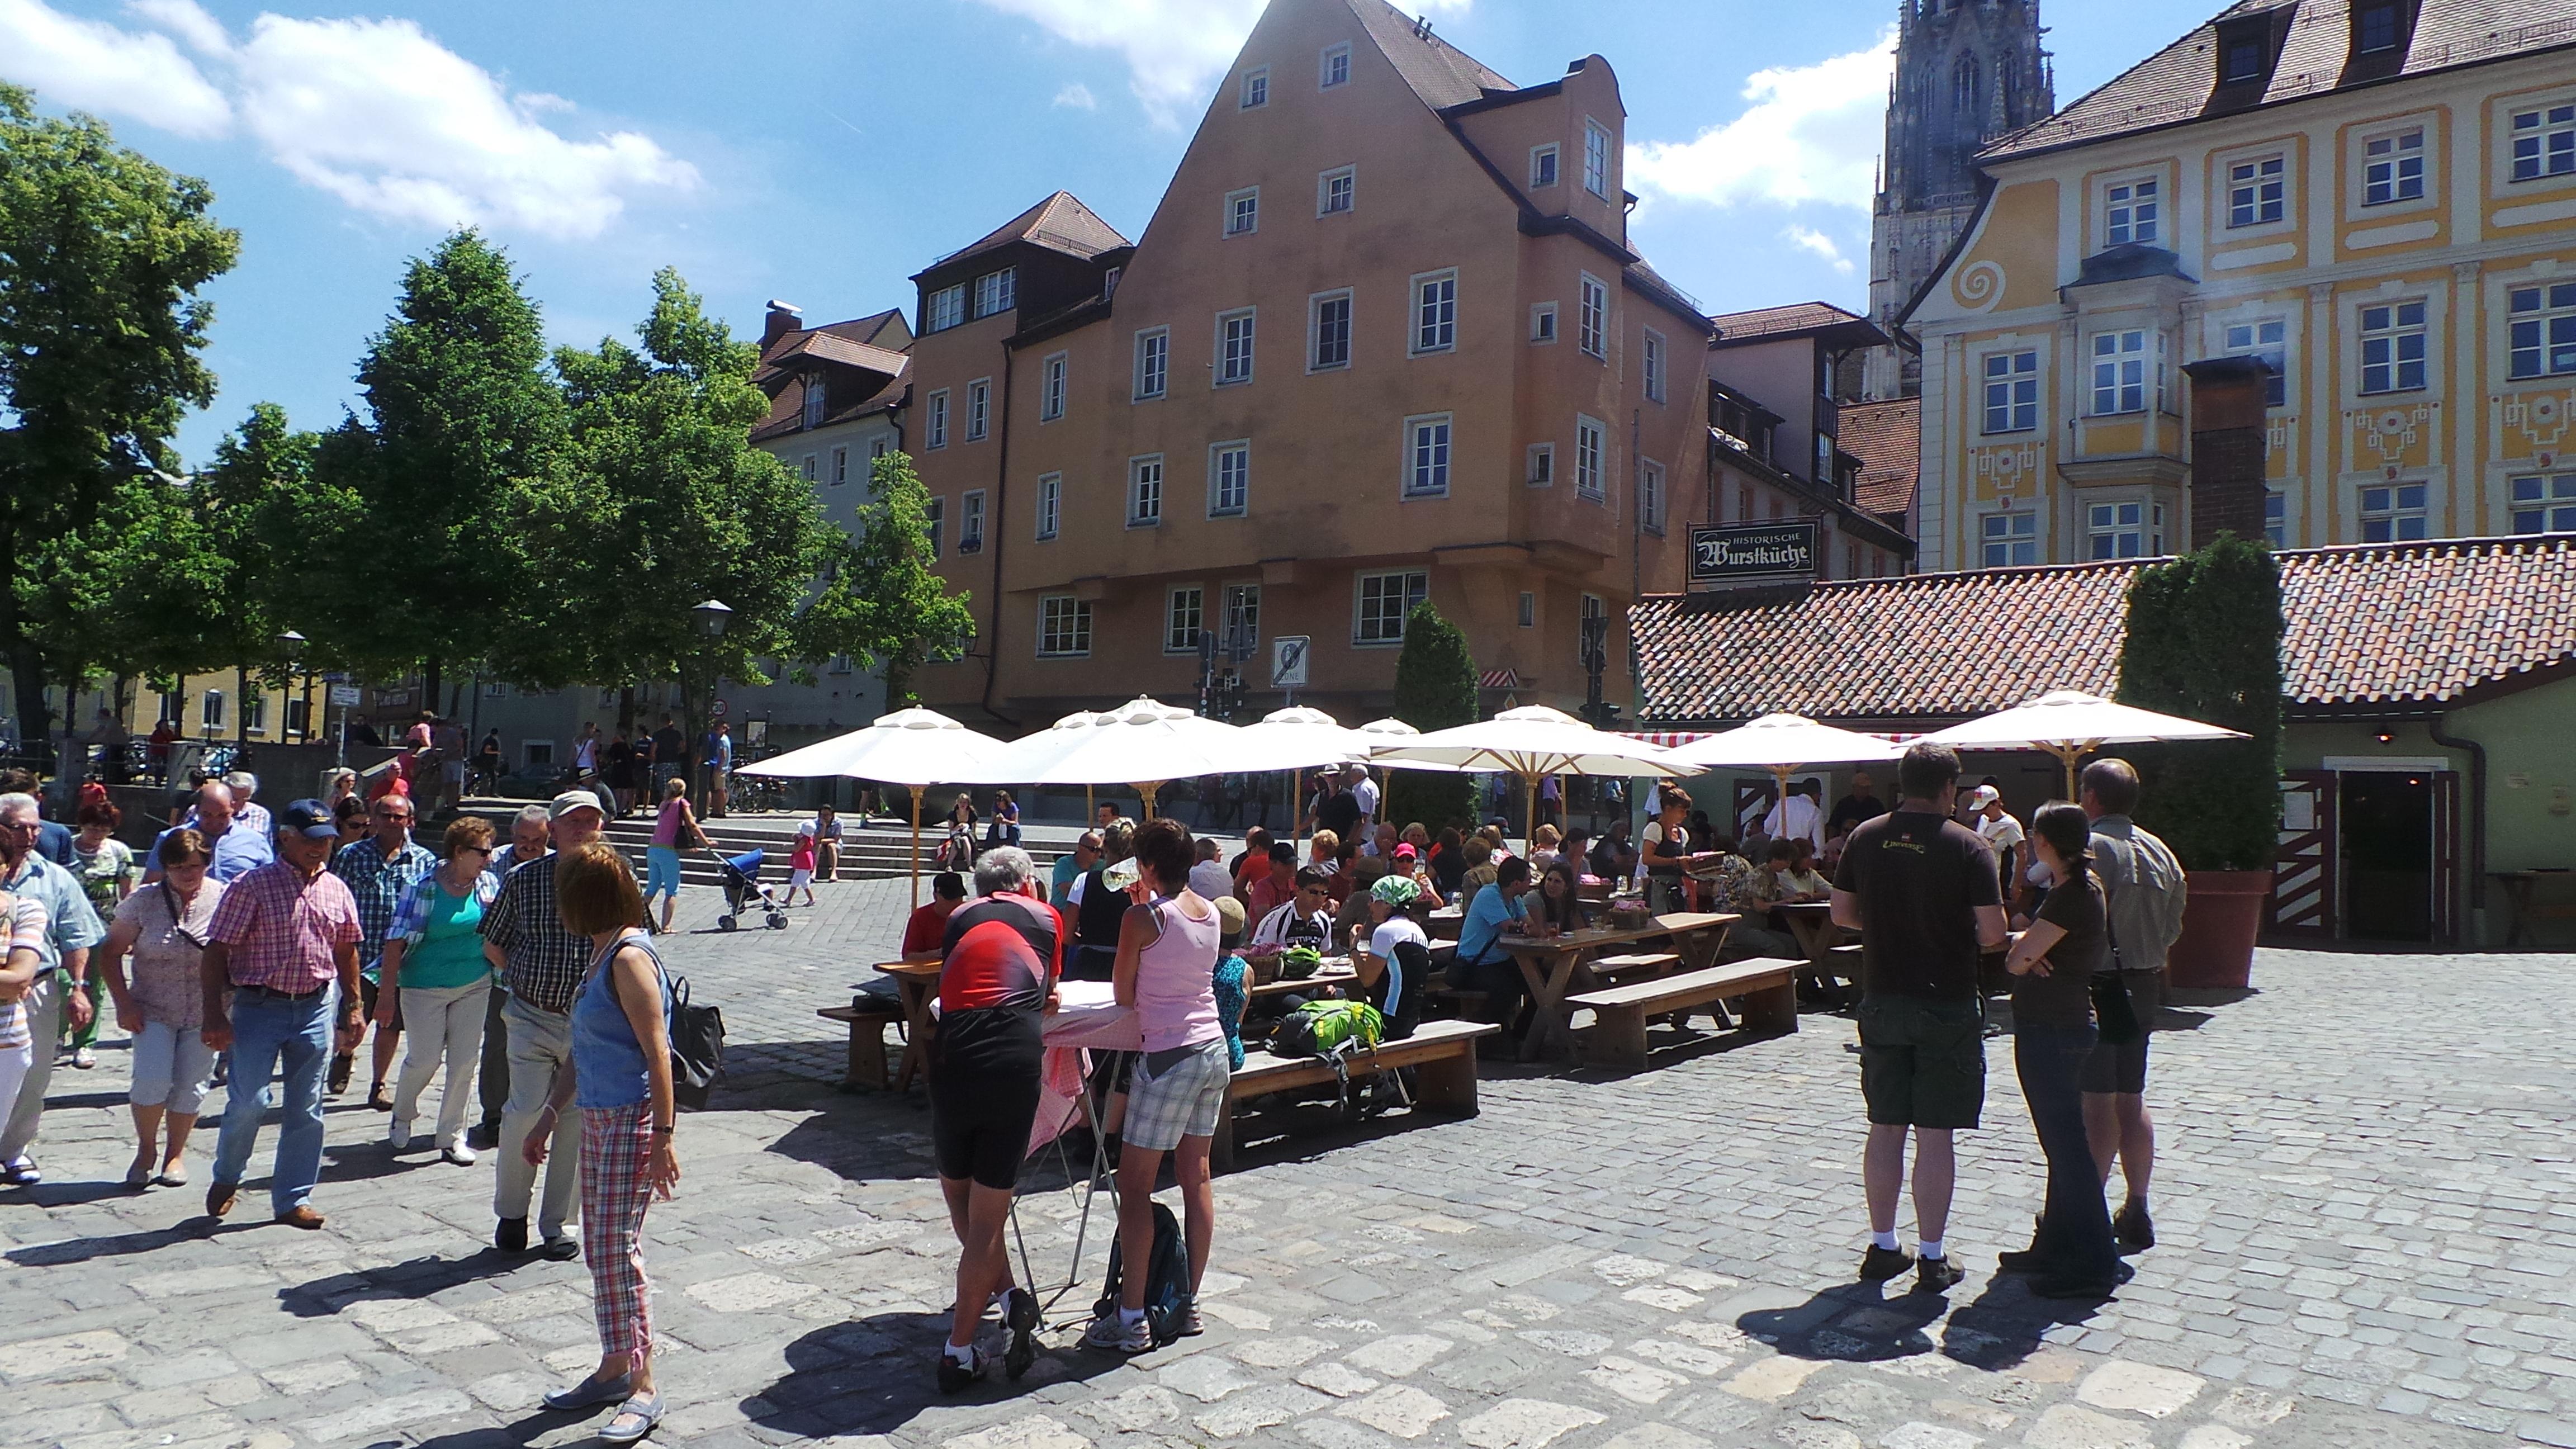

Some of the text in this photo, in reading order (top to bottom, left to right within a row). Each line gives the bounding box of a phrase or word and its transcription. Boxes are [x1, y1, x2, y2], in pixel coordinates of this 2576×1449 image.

[1734, 533, 1801, 544] HISTORISCHE
[1697, 533, 1810, 569] Wurstküche
[1882, 840, 1925, 854] UNIVERSE
